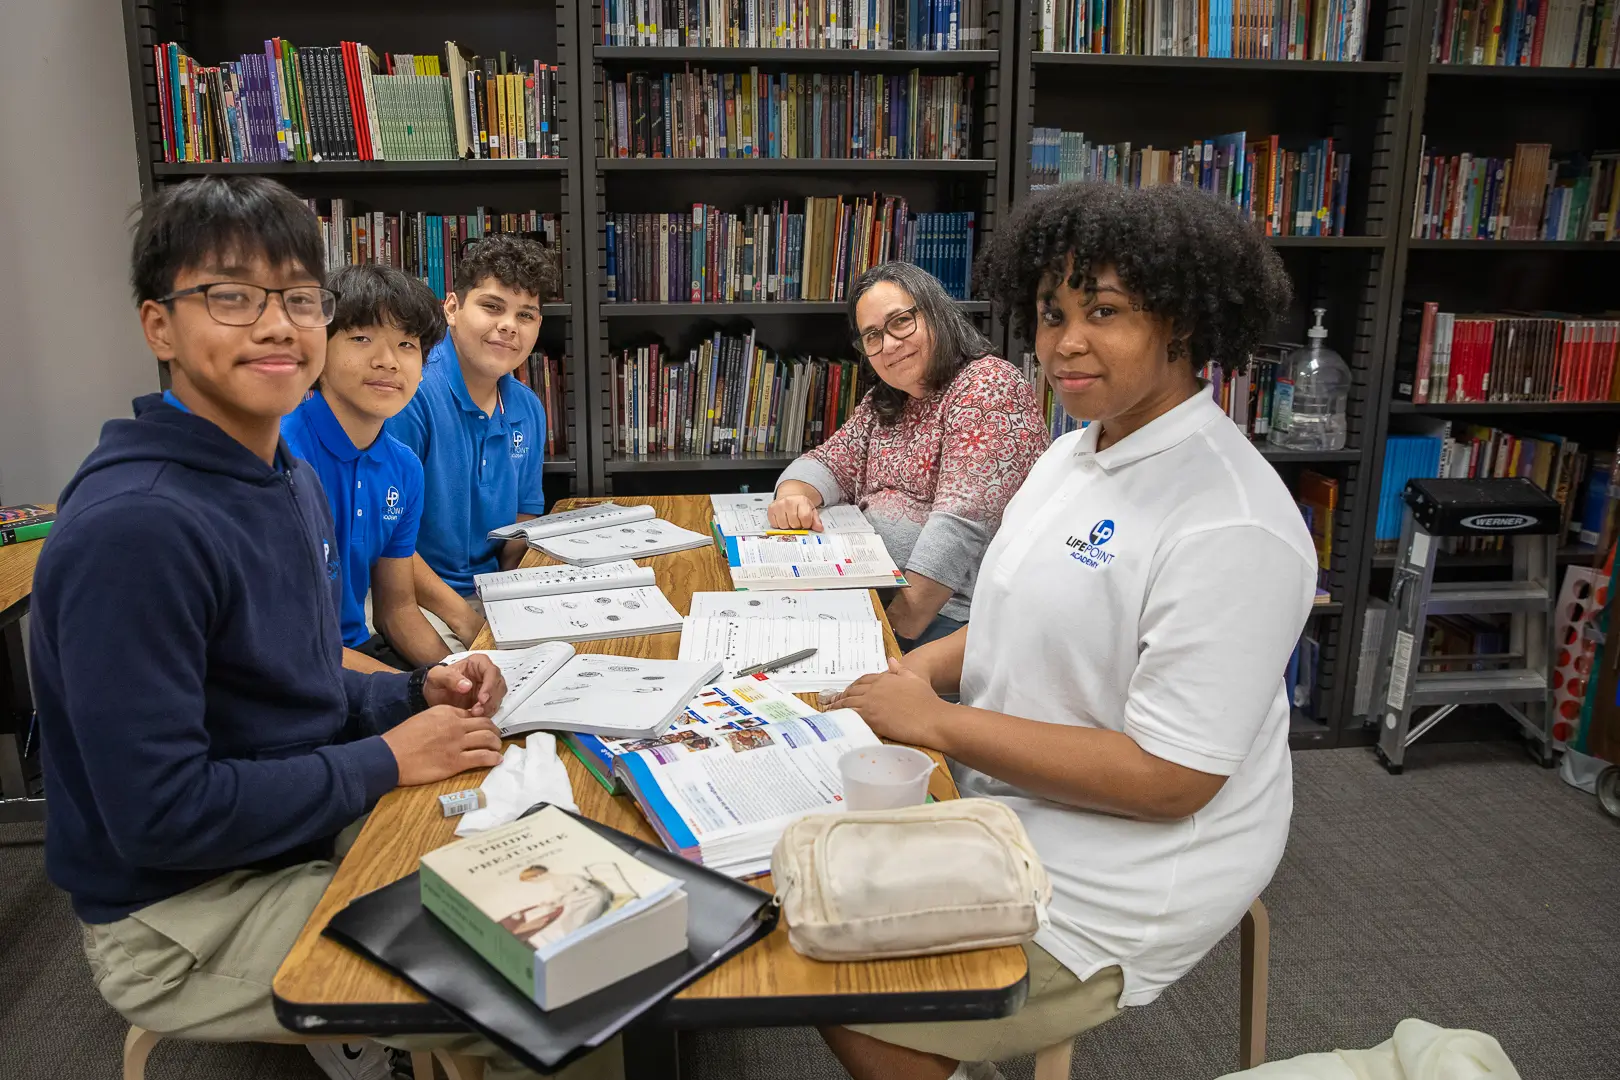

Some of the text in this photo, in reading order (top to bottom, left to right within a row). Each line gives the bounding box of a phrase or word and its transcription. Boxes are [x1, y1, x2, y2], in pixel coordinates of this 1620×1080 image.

[1476, 518, 1524, 526] WERNER
[1066, 536, 1115, 564] LIFEPOINT
[1070, 552, 1099, 568] ACADEMY
[468, 832, 568, 874] PREJUDICE
[478, 832, 534, 856] PRIDE
